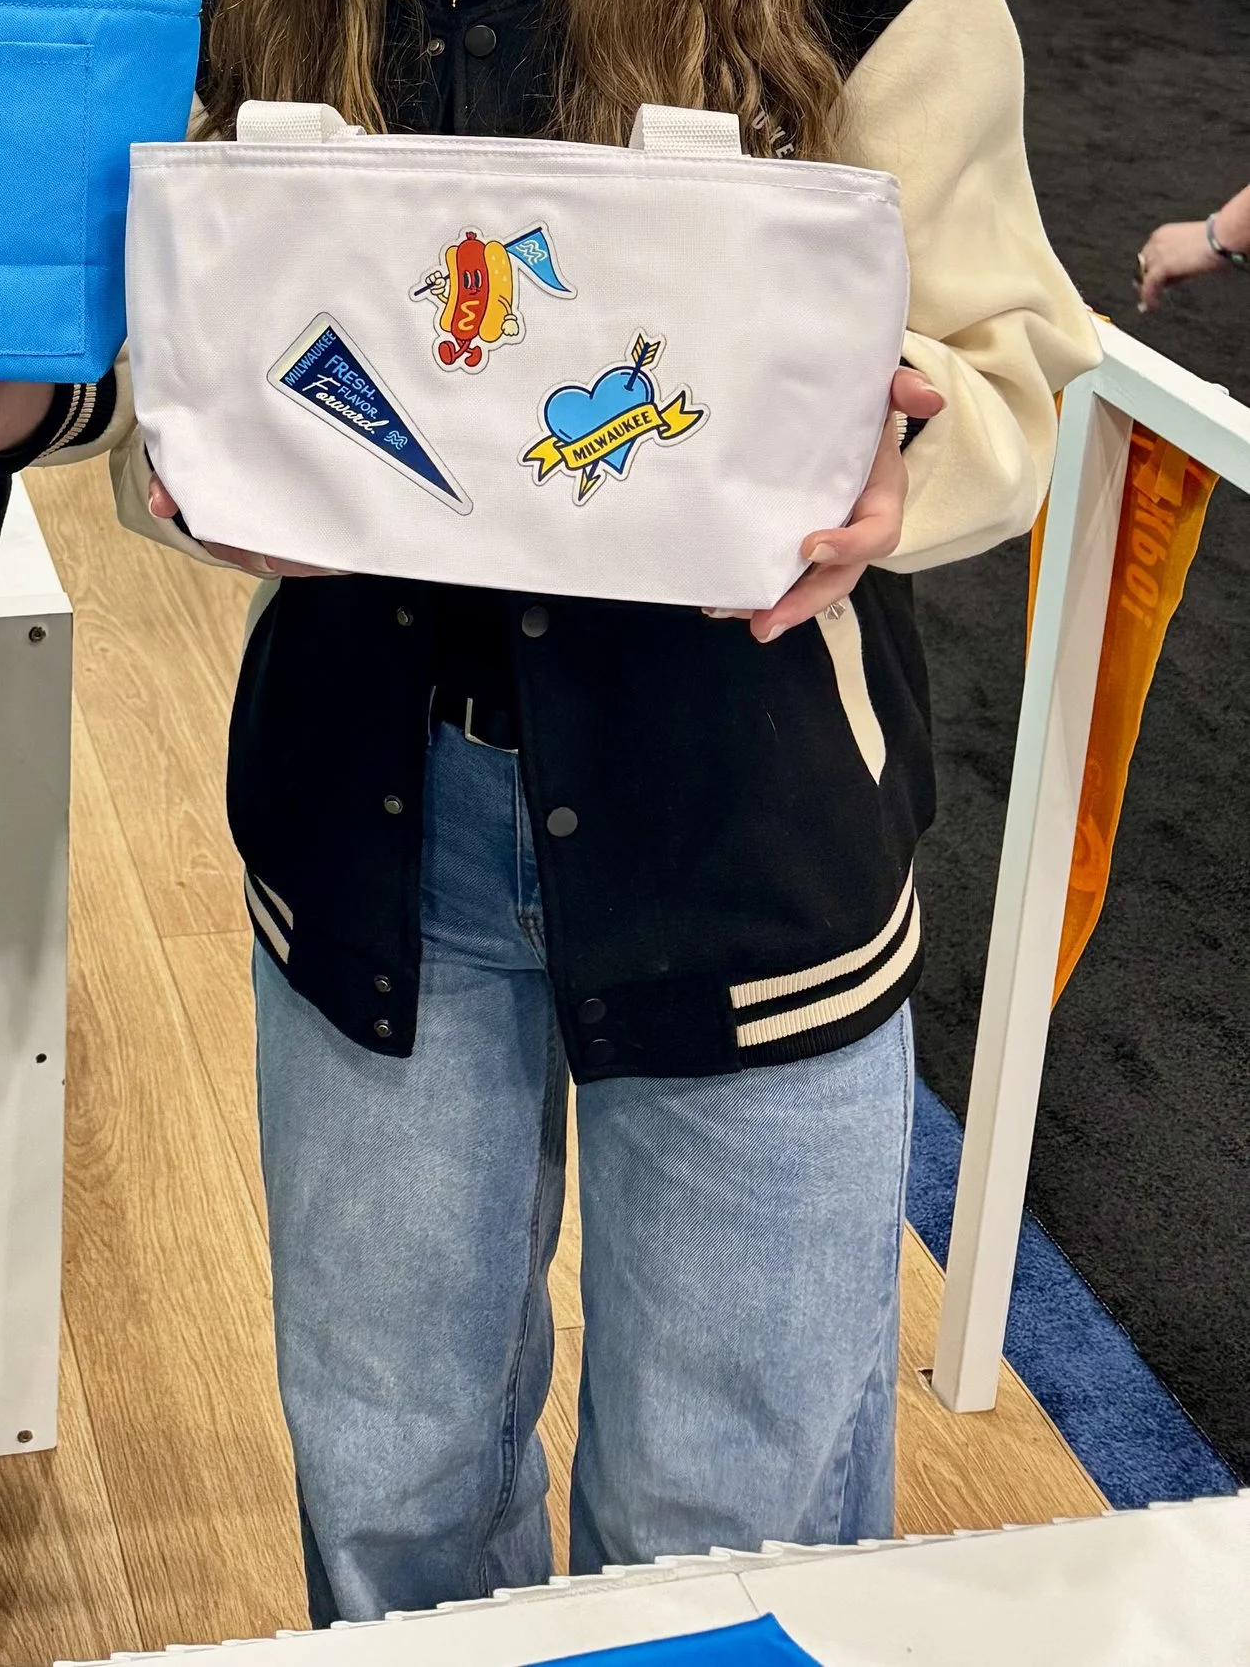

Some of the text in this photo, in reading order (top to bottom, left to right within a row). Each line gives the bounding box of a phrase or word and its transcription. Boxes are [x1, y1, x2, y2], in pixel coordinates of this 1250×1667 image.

[284, 329, 337, 387] MILWAUKEE
[324, 354, 375, 401] FRESH.
[302, 374, 390, 434] Forward.
[338, 385, 379, 420] FLAVOR.
[572, 411, 653, 465] MILWAUKEE
